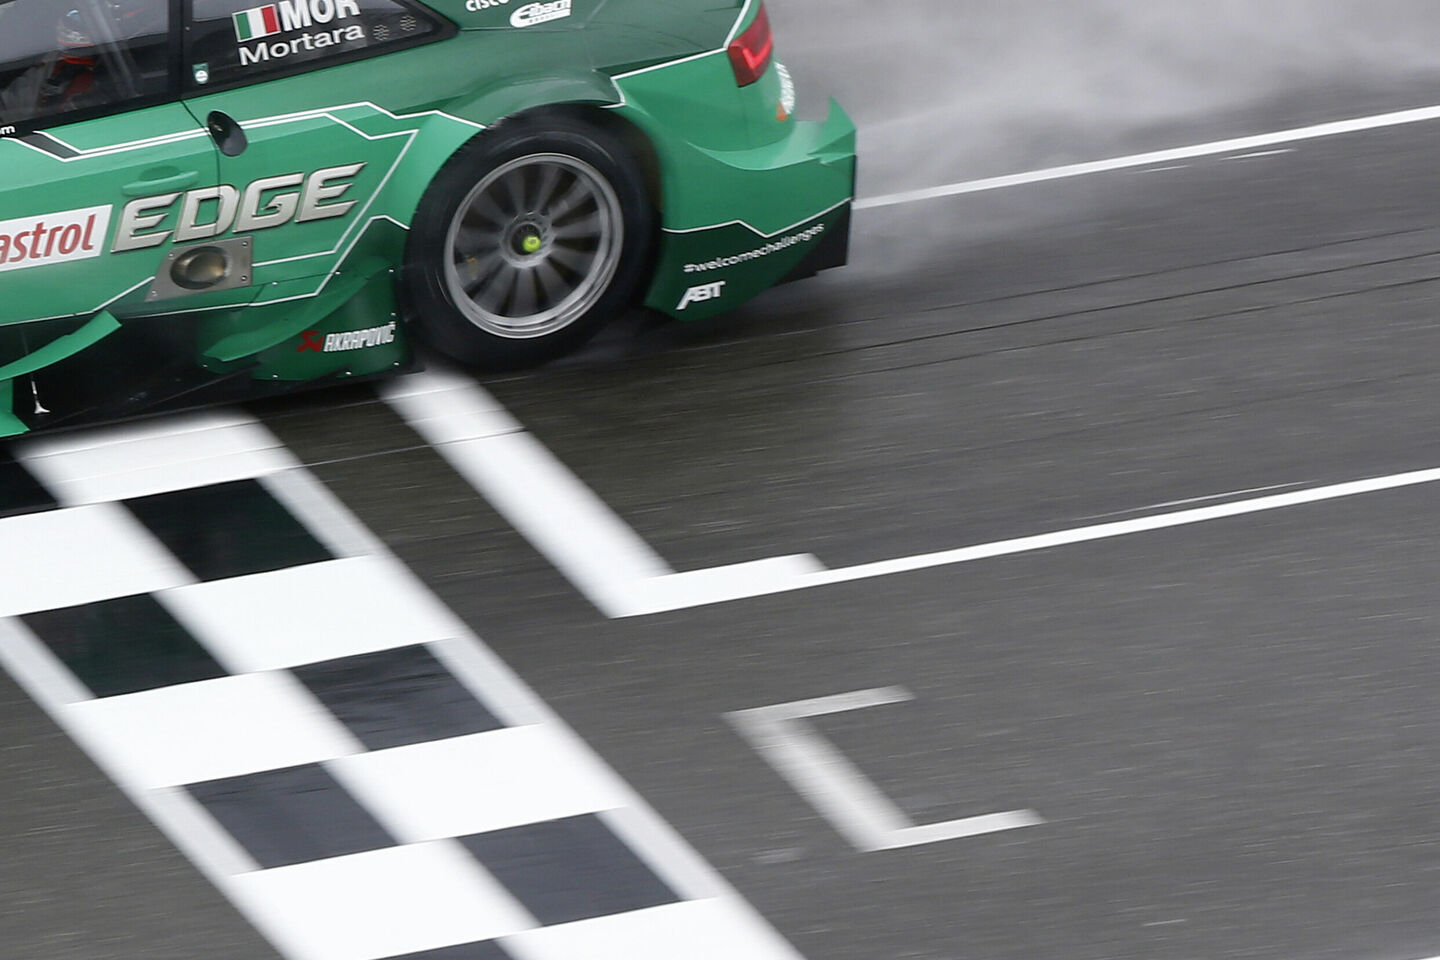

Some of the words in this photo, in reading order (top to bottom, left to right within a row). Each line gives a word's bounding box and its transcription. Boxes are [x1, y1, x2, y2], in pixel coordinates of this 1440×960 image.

[238, 24, 365, 66] Mortara
[111, 162, 368, 253] EDGE
[683, 223, 825, 273] #welcomechallenges
[676, 281, 726, 310] ABT
